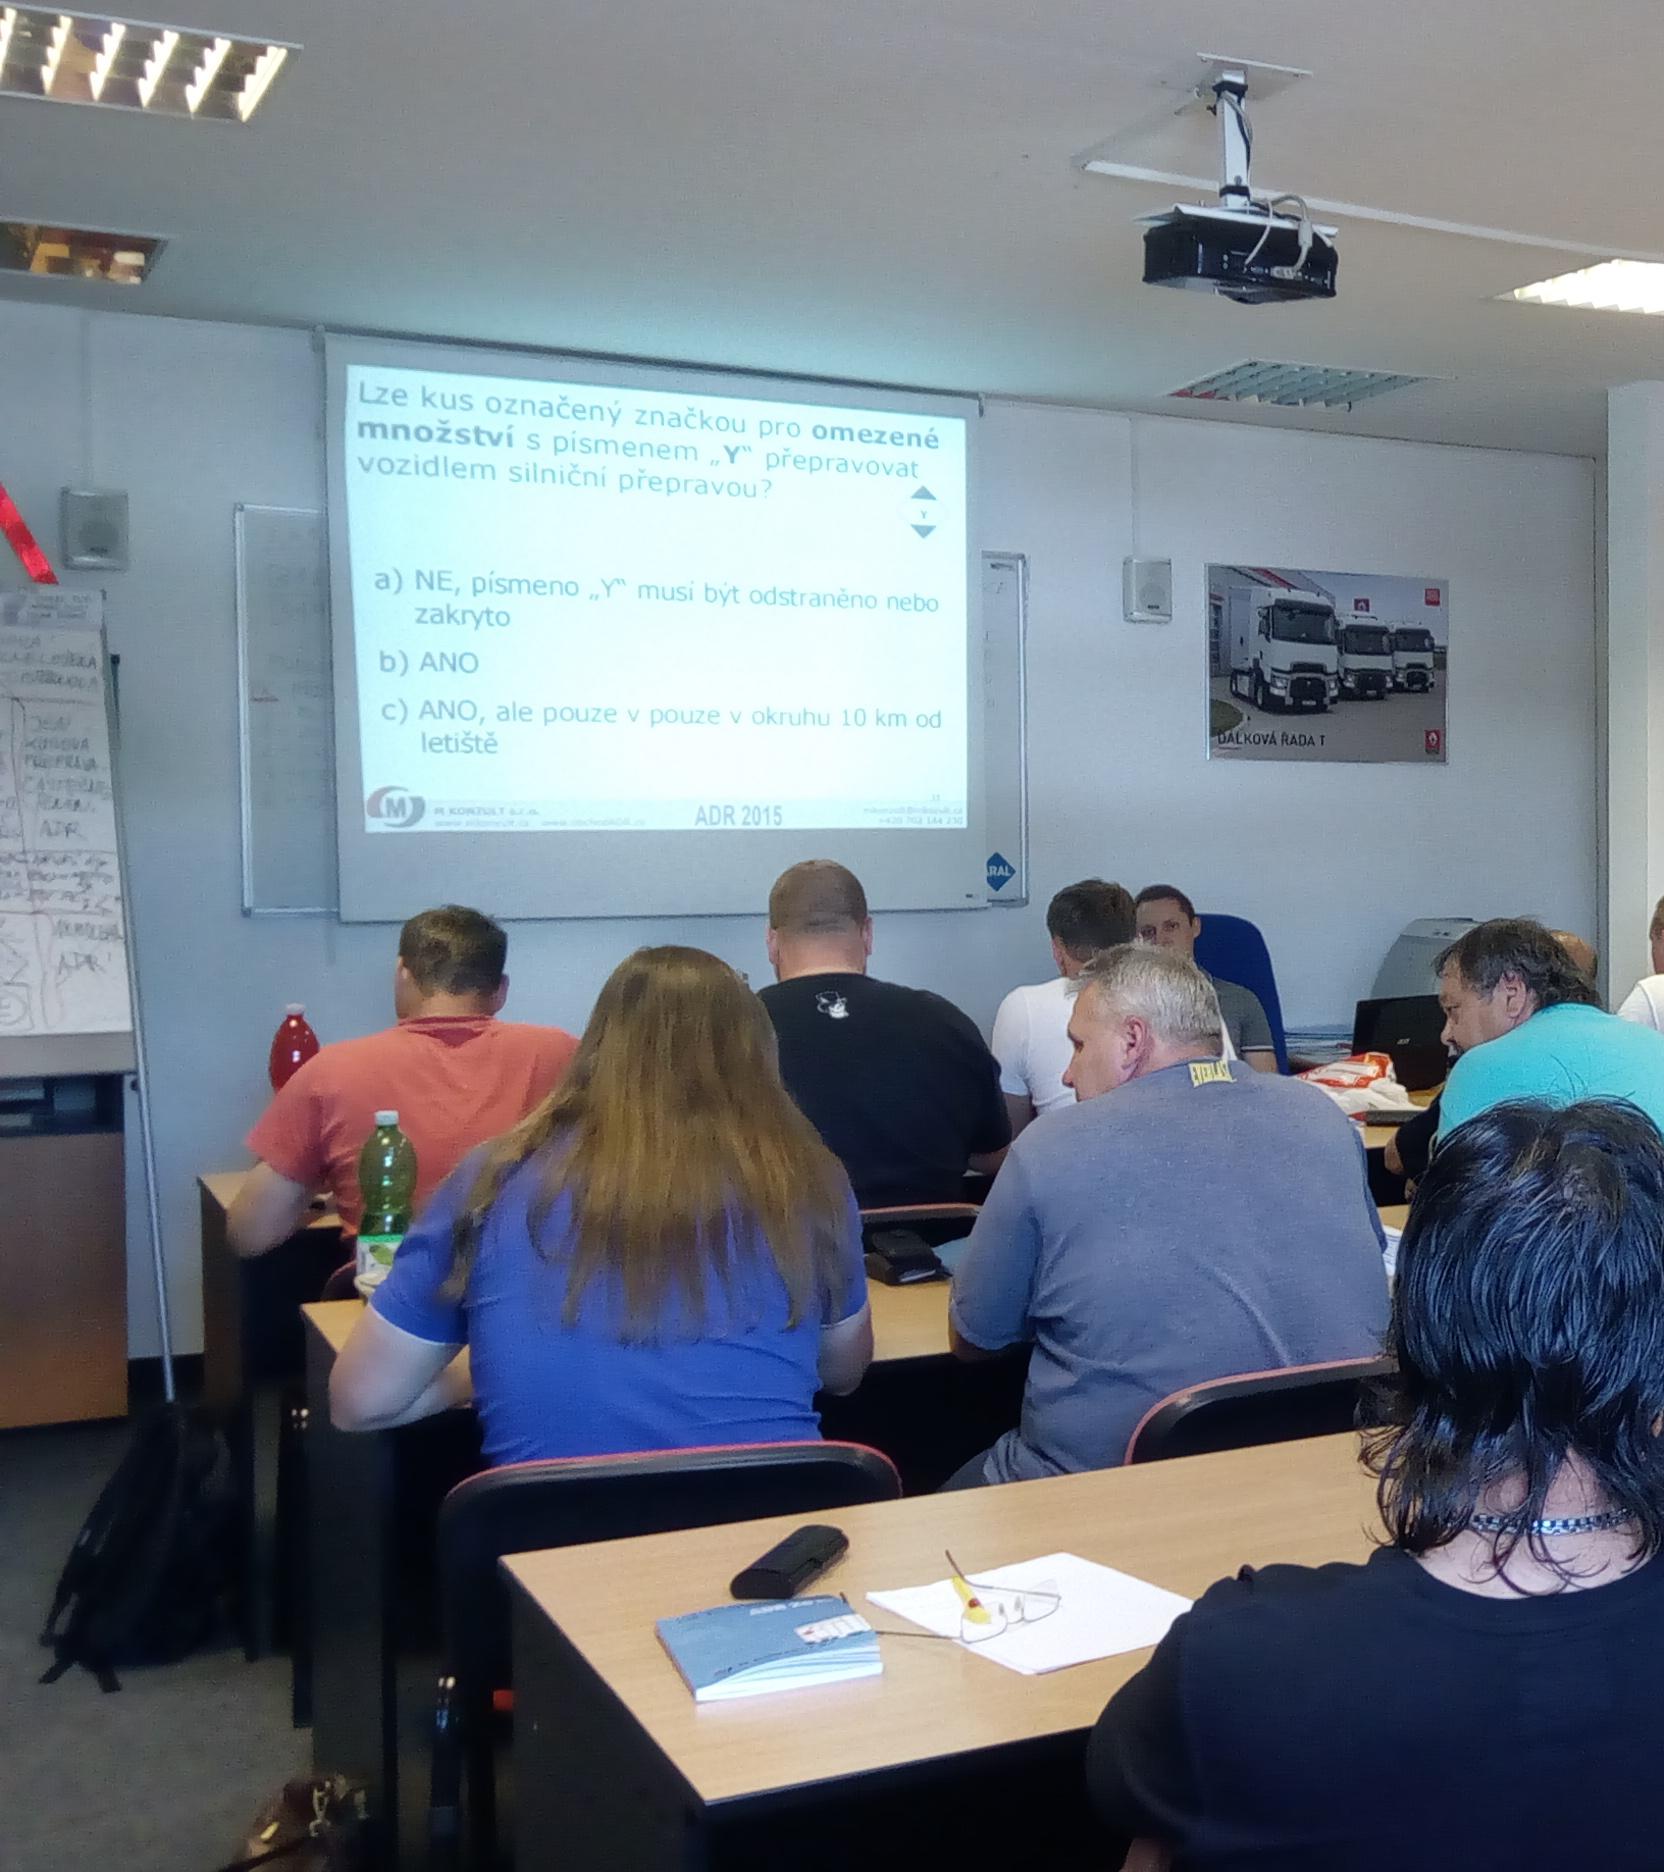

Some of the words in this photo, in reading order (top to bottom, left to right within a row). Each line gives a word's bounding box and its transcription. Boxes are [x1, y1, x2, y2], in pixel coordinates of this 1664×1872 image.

[360, 382, 408, 407] Lze
[421, 385, 474, 412] kus
[485, 394, 622, 427] označený
[635, 406, 746, 433] značkou
[759, 417, 801, 439] pro
[812, 424, 939, 449] omezené
[357, 419, 514, 448] množství
[526, 432, 541, 450] s
[553, 430, 698, 461] písmenem
[766, 448, 919, 479] přepravovat
[357, 453, 496, 481] vozidlem
[508, 462, 607, 487] silniční
[619, 467, 772, 499] přepravou?
[374, 567, 403, 595] a)
[415, 569, 461, 596] NE,
[472, 570, 580, 597] písmeno
[638, 579, 695, 602] musí
[704, 581, 741, 608] být
[749, 586, 878, 610] odstraněno
[887, 592, 939, 613] nebo
[415, 603, 511, 631] zakryto
[379, 650, 409, 677] b)
[419, 651, 479, 674] ANO
[381, 698, 408, 725] c)
[418, 699, 486, 725] ANO,
[496, 701, 533, 723] ale
[543, 705, 618, 727] pouze
[627, 709, 640, 723] v
[650, 707, 721, 728] pouze
[729, 710, 742, 724] v
[751, 706, 831, 728] okruhu
[842, 707, 867, 727] 10
[875, 709, 907, 728] km
[915, 711, 942, 729] od
[421, 730, 499, 755] letiště
[694, 805, 735, 827] ADR
[741, 804, 783, 827] 2015
[987, 865, 1011, 877] RAL
